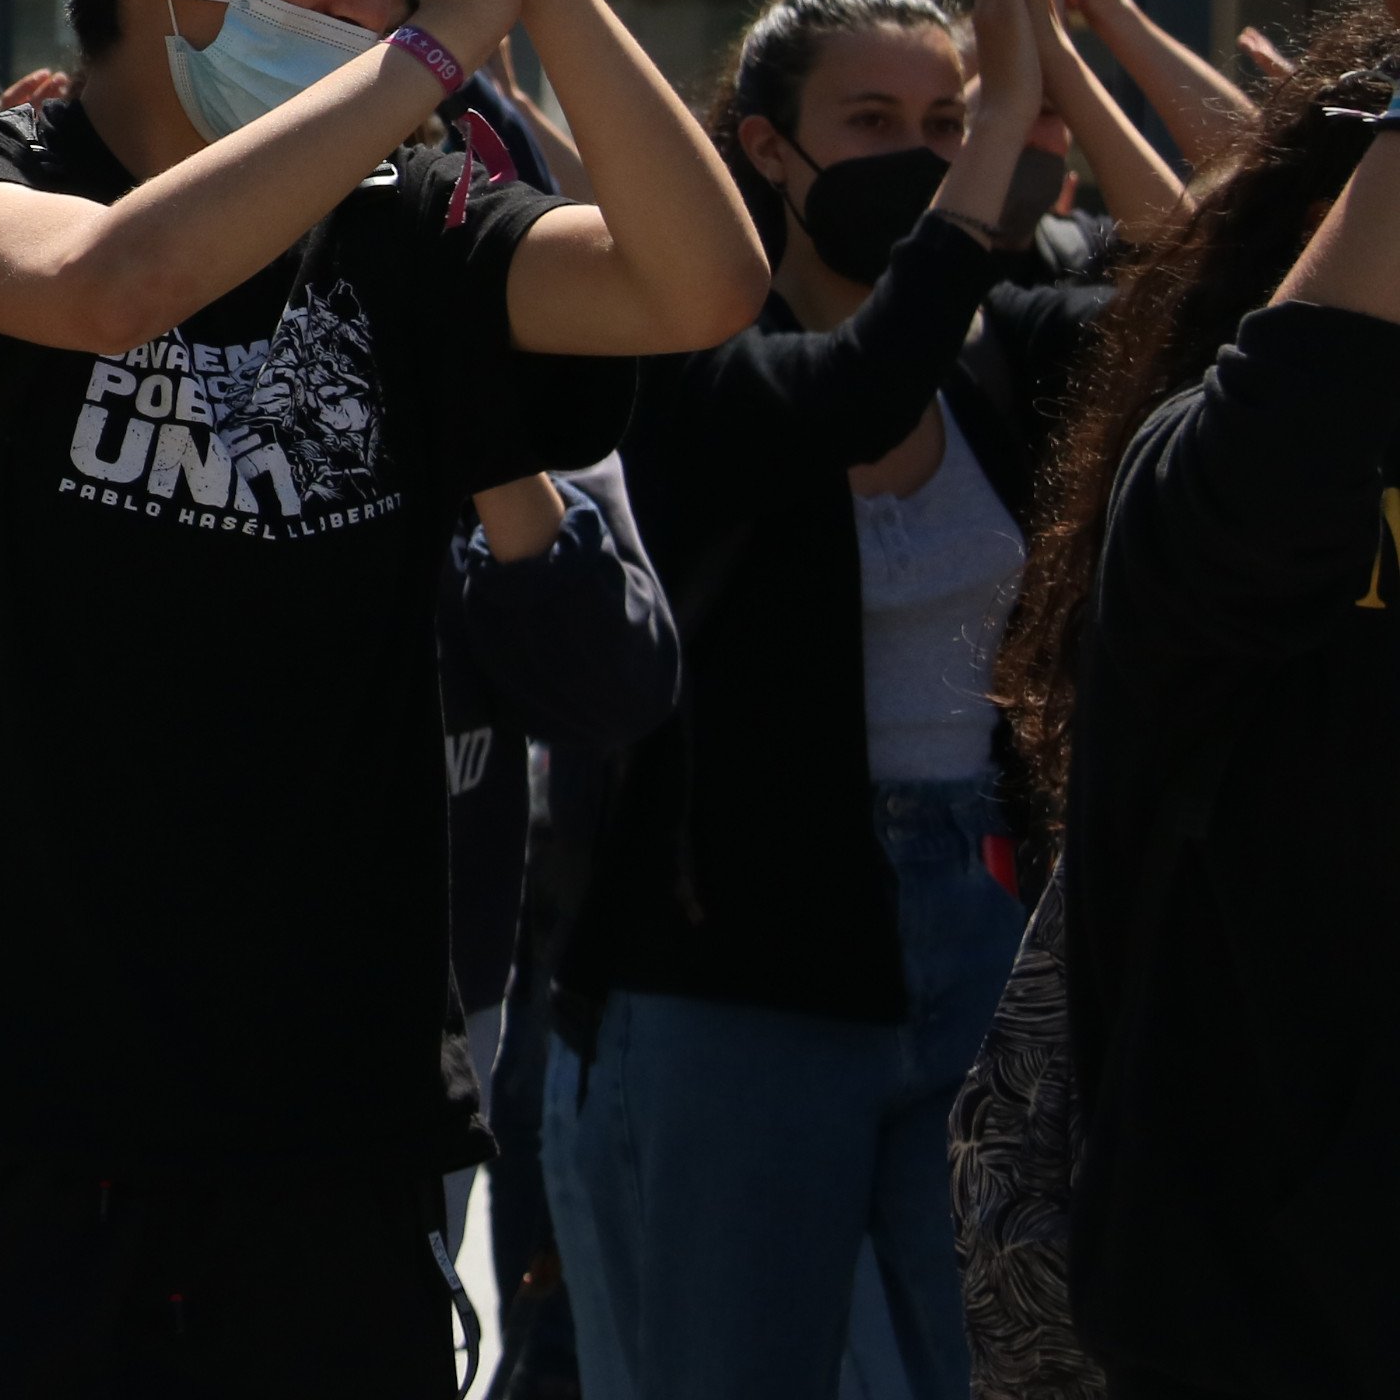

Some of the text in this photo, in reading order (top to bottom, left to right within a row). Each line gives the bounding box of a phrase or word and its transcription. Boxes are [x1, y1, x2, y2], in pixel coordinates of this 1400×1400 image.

[57, 477, 401, 541] PABLO HASÉL LLIBERTAT
